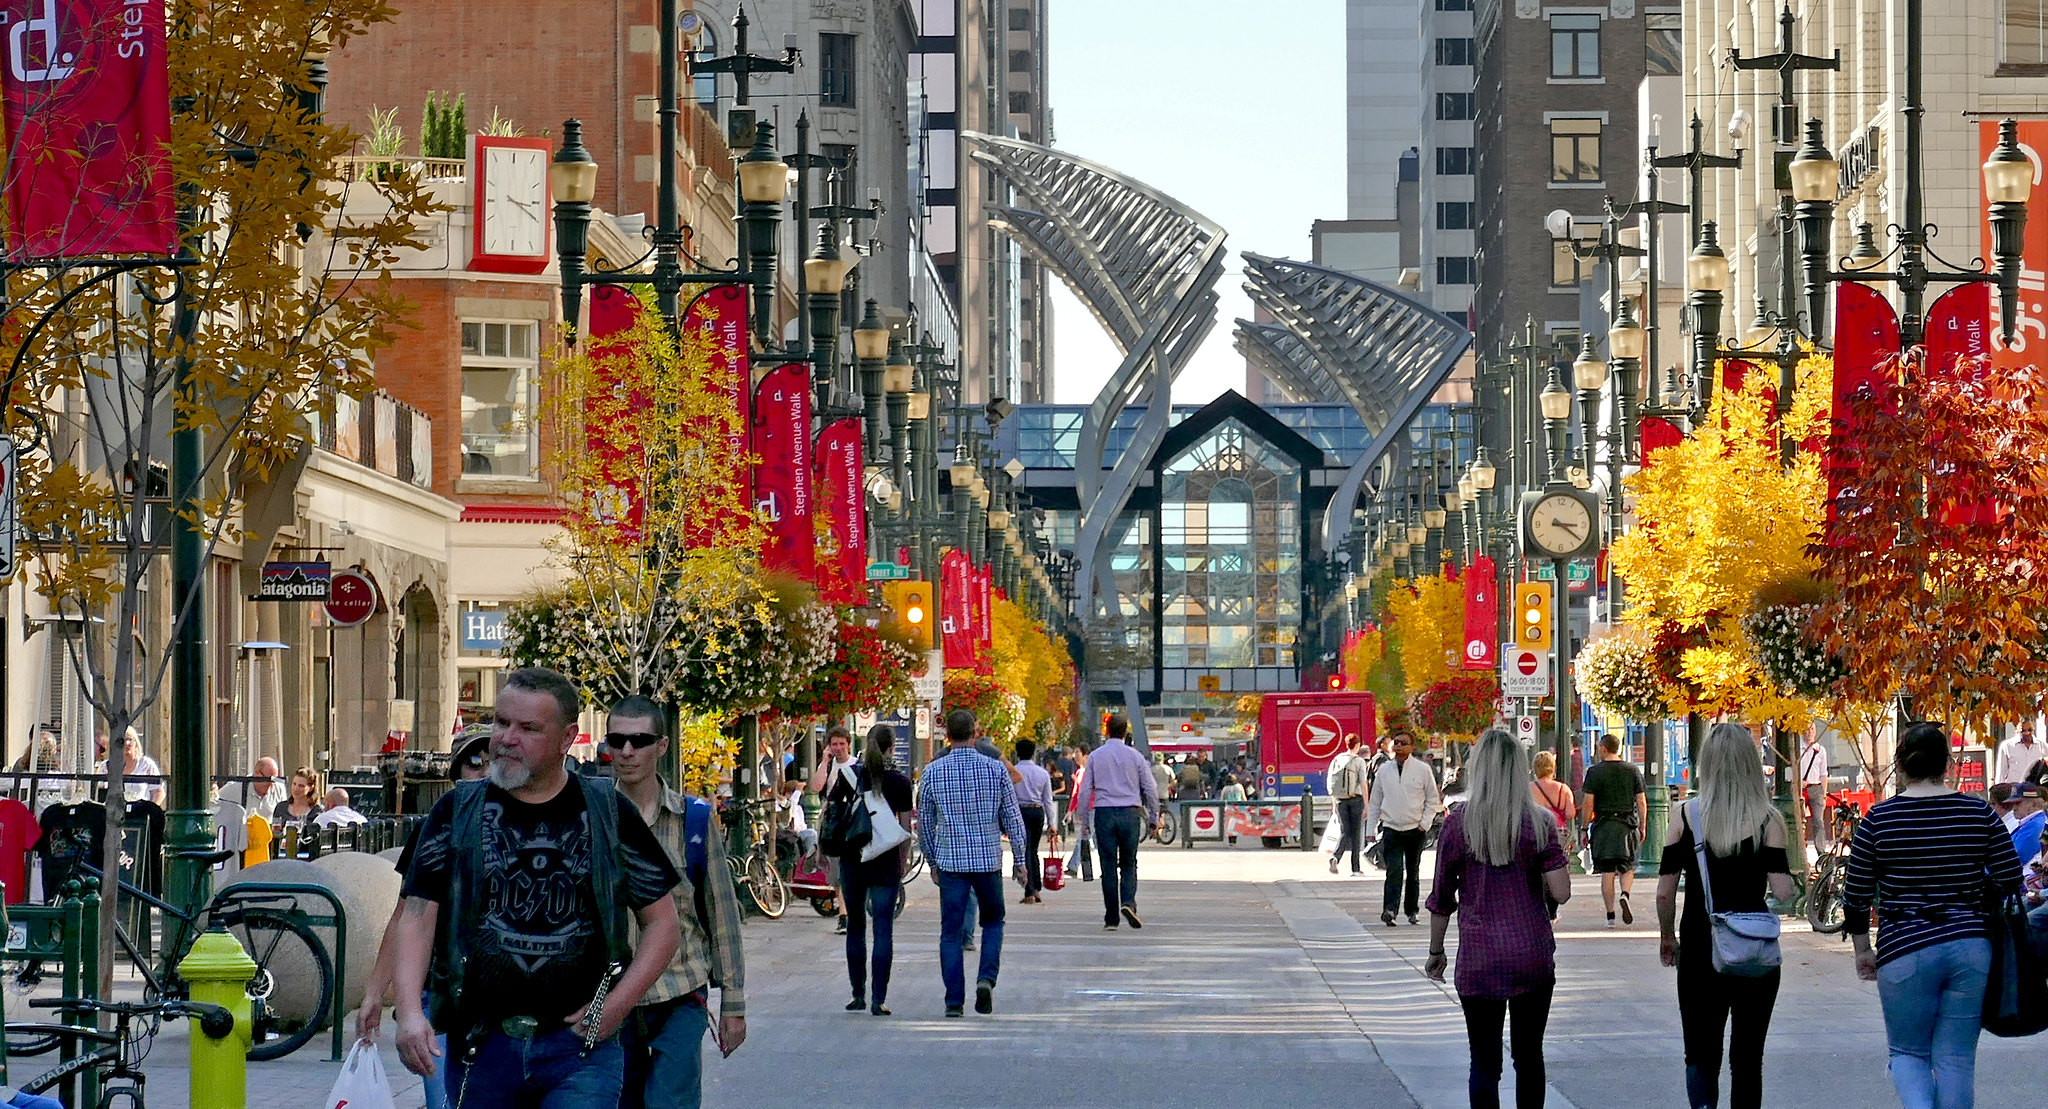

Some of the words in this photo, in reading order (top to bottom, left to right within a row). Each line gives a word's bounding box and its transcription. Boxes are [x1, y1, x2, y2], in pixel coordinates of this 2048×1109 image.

[723, 320, 737, 351] Walk
[1966, 318, 1981, 352] Walk
[789, 391, 802, 421] Walk
[792, 422, 804, 465] Avenue
[843, 441, 855, 467] Walk
[793, 468, 806, 516] Stephen
[845, 466, 856, 505] Avenue
[1557, 497, 1566, 506] 12
[847, 507, 860, 549] Stephen
[1535, 520, 1541, 529] 9
[1581, 520, 1587, 529] 3
[1558, 543, 1564, 552] 6
[1573, 570, 1585, 578] SW
[256, 582, 326, 599] atagonia
[31, 1052, 100, 1090] DIADORA
